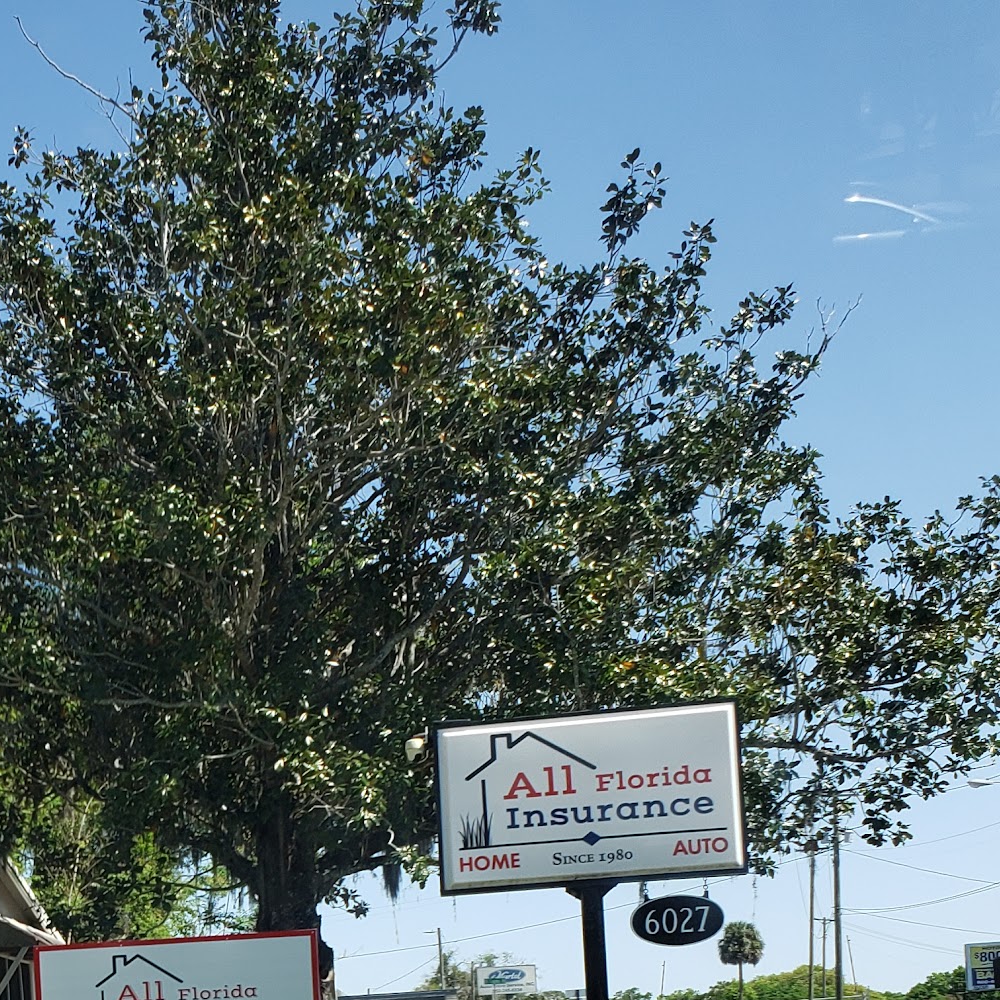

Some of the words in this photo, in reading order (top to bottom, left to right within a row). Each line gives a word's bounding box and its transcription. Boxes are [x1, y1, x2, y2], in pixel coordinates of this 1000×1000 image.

[503, 765, 577, 800] All
[596, 765, 712, 792] Florida
[506, 796, 714, 829] Insurance
[672, 836, 729, 856] AUTO
[459, 853, 521, 872] HOME
[599, 850, 633, 864] 1980
[645, 905, 710, 934] 6027
[178, 984, 258, 1000] Florida
